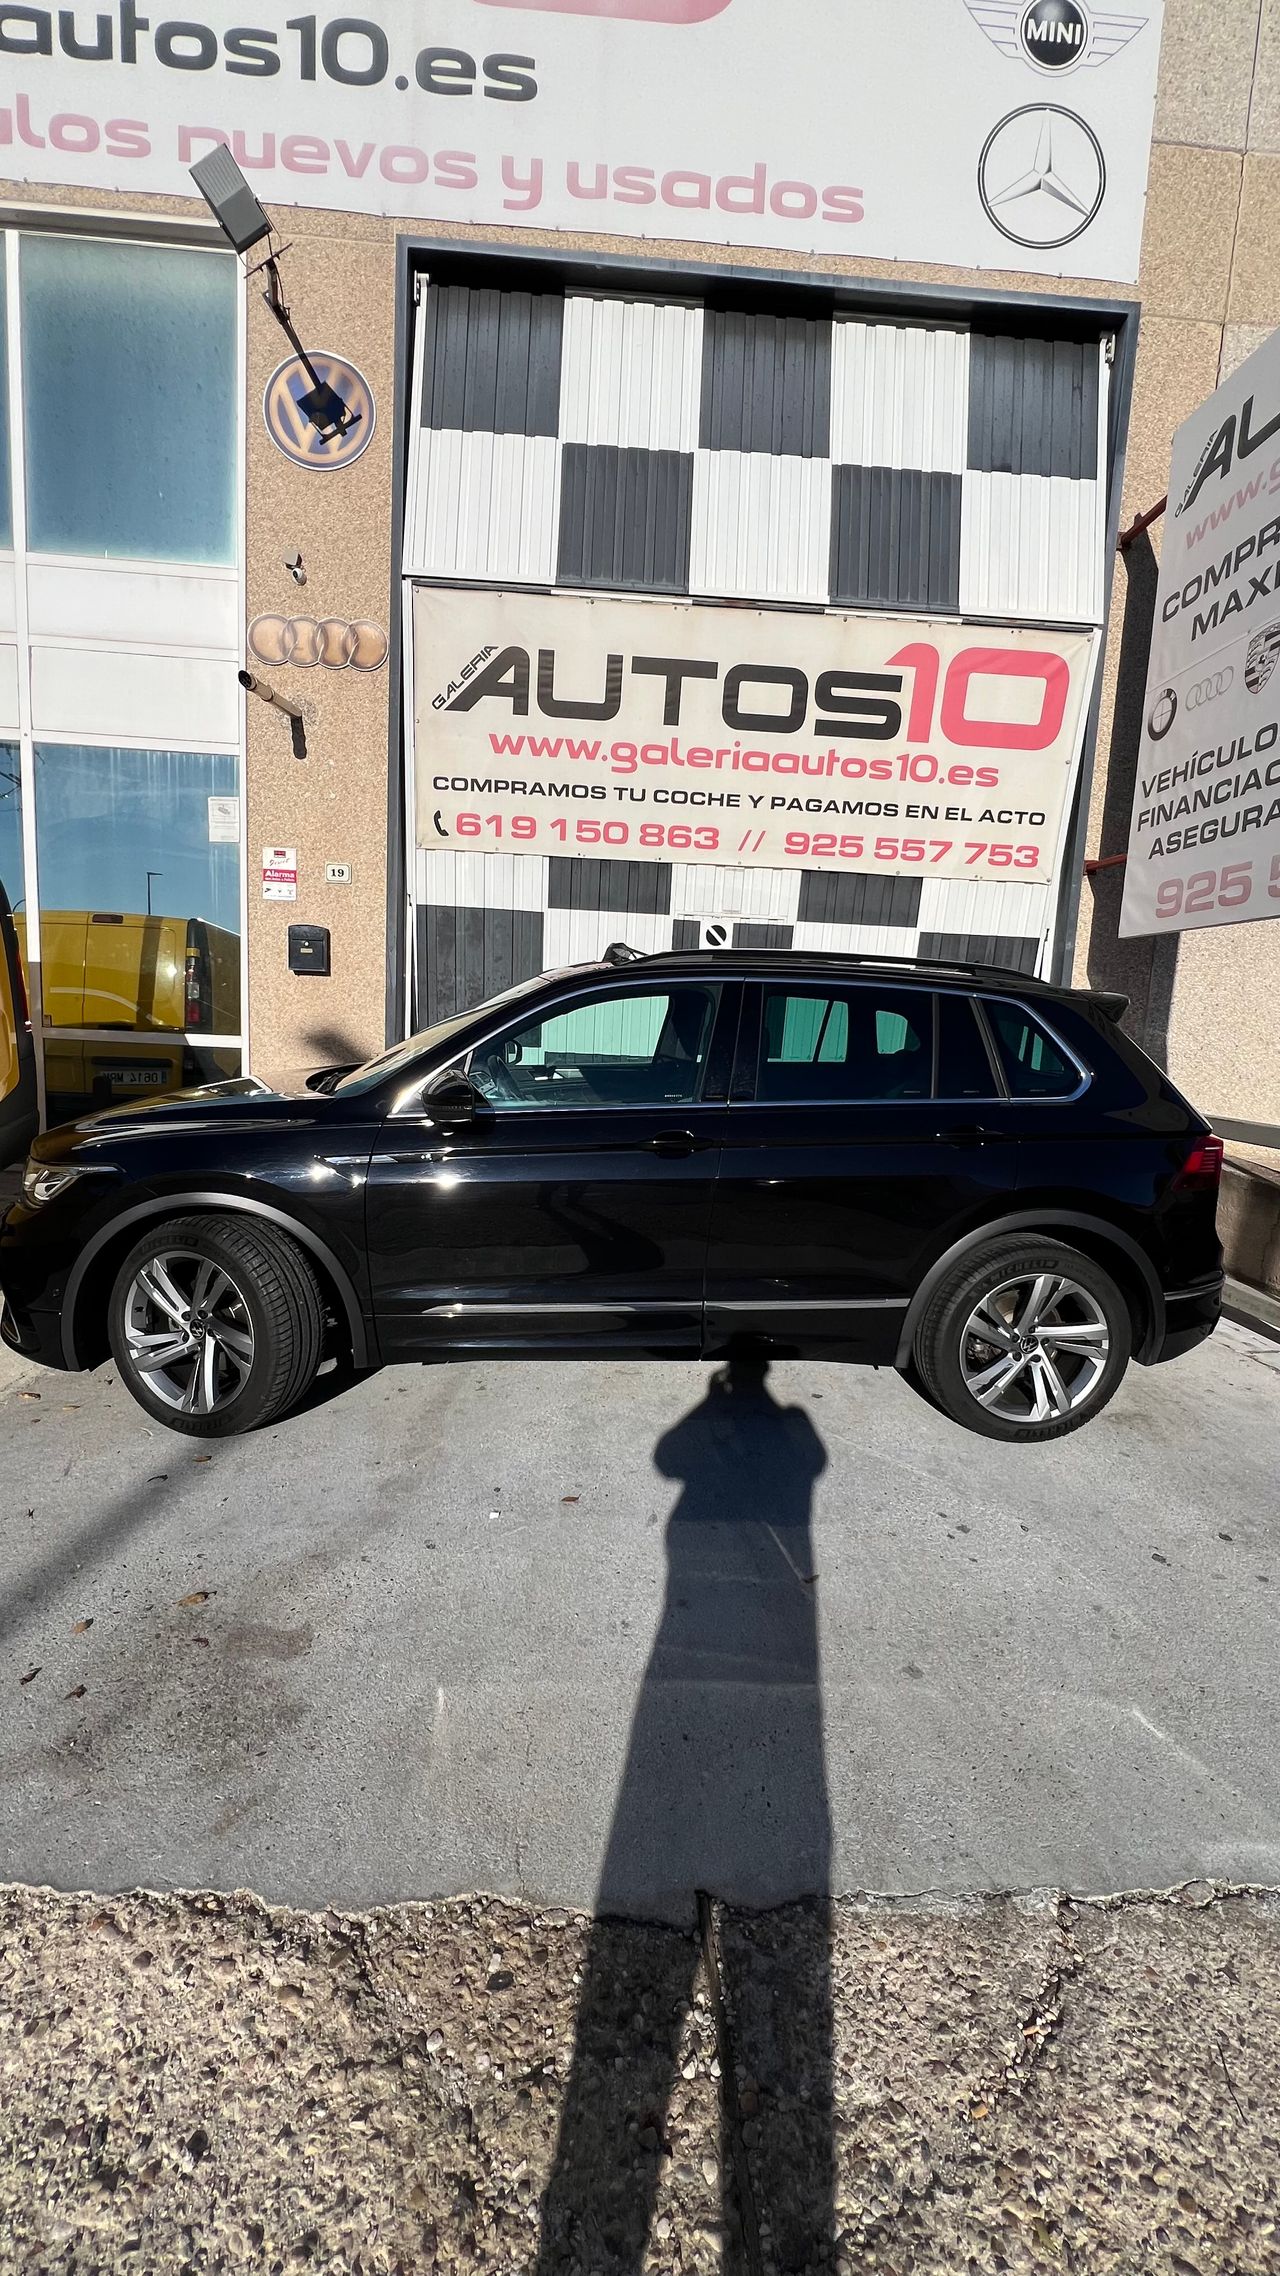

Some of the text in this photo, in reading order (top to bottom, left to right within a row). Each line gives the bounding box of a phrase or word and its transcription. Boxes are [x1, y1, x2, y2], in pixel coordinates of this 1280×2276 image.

[1026, 18, 1083, 46] MINI
[178, 124, 478, 190] nuevos
[501, 156, 543, 210] y
[566, 161, 865, 223] usados
[432, 646, 499, 709] GALERIA
[489, 734, 999, 787] www.galeriaautos10.es
[433, 776, 1046, 826] COMPRAMOS TU COCHE Y PAGAMOS EN EL ACTO
[456, 812, 537, 839] 619
[550, 818, 629, 844] 150
[639, 823, 720, 849] 863
[784, 831, 864, 858] 925
[874, 837, 953, 862] 557
[964, 842, 1039, 868] 753
[265, 870, 295, 878] Alarma
[331, 869, 345, 877] 19
[1155, 861, 1253, 918] 925
